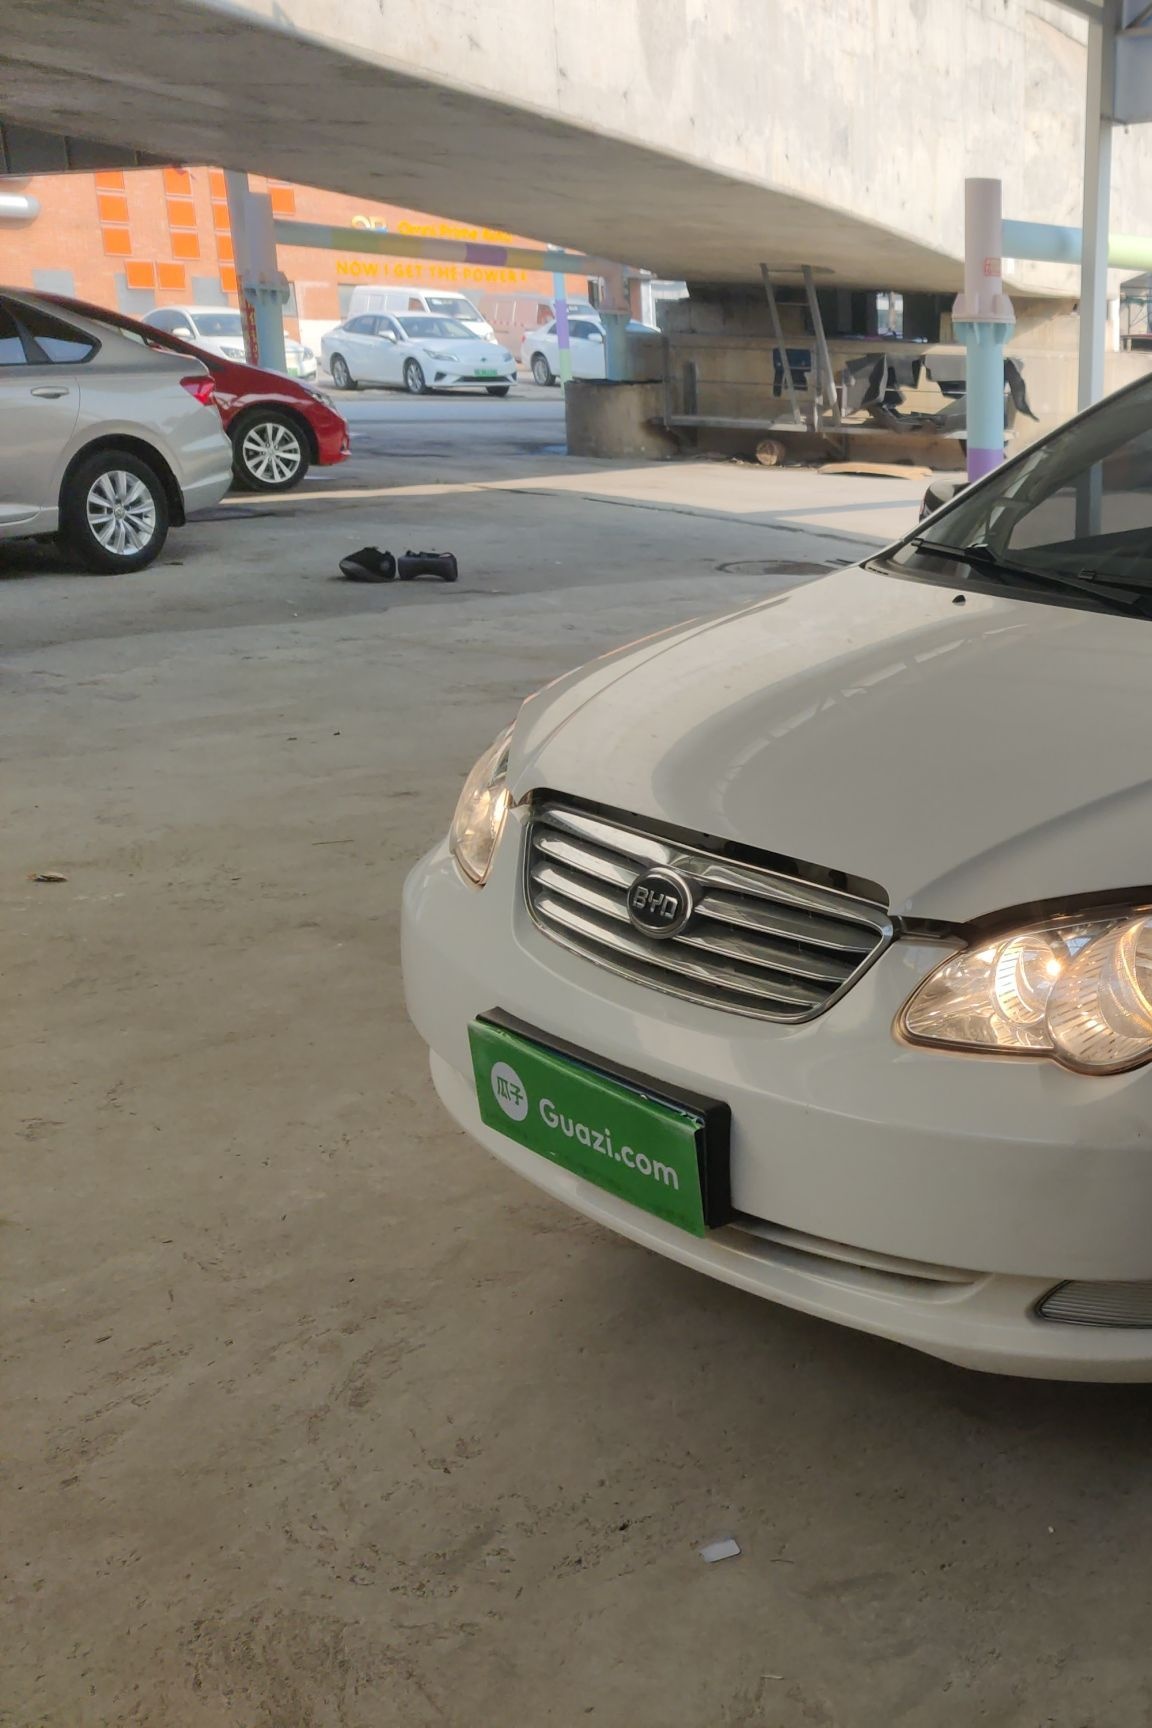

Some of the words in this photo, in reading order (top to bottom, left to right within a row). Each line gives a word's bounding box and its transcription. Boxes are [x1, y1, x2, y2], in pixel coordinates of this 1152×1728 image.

[336, 260, 378, 277] NOW
[394, 264, 422, 279] GET
[429, 265, 457, 281] THE
[633, 885, 678, 919] BYD
[496, 1076, 524, 1105] 瓜子
[539, 1098, 679, 1190] Guazi.com
